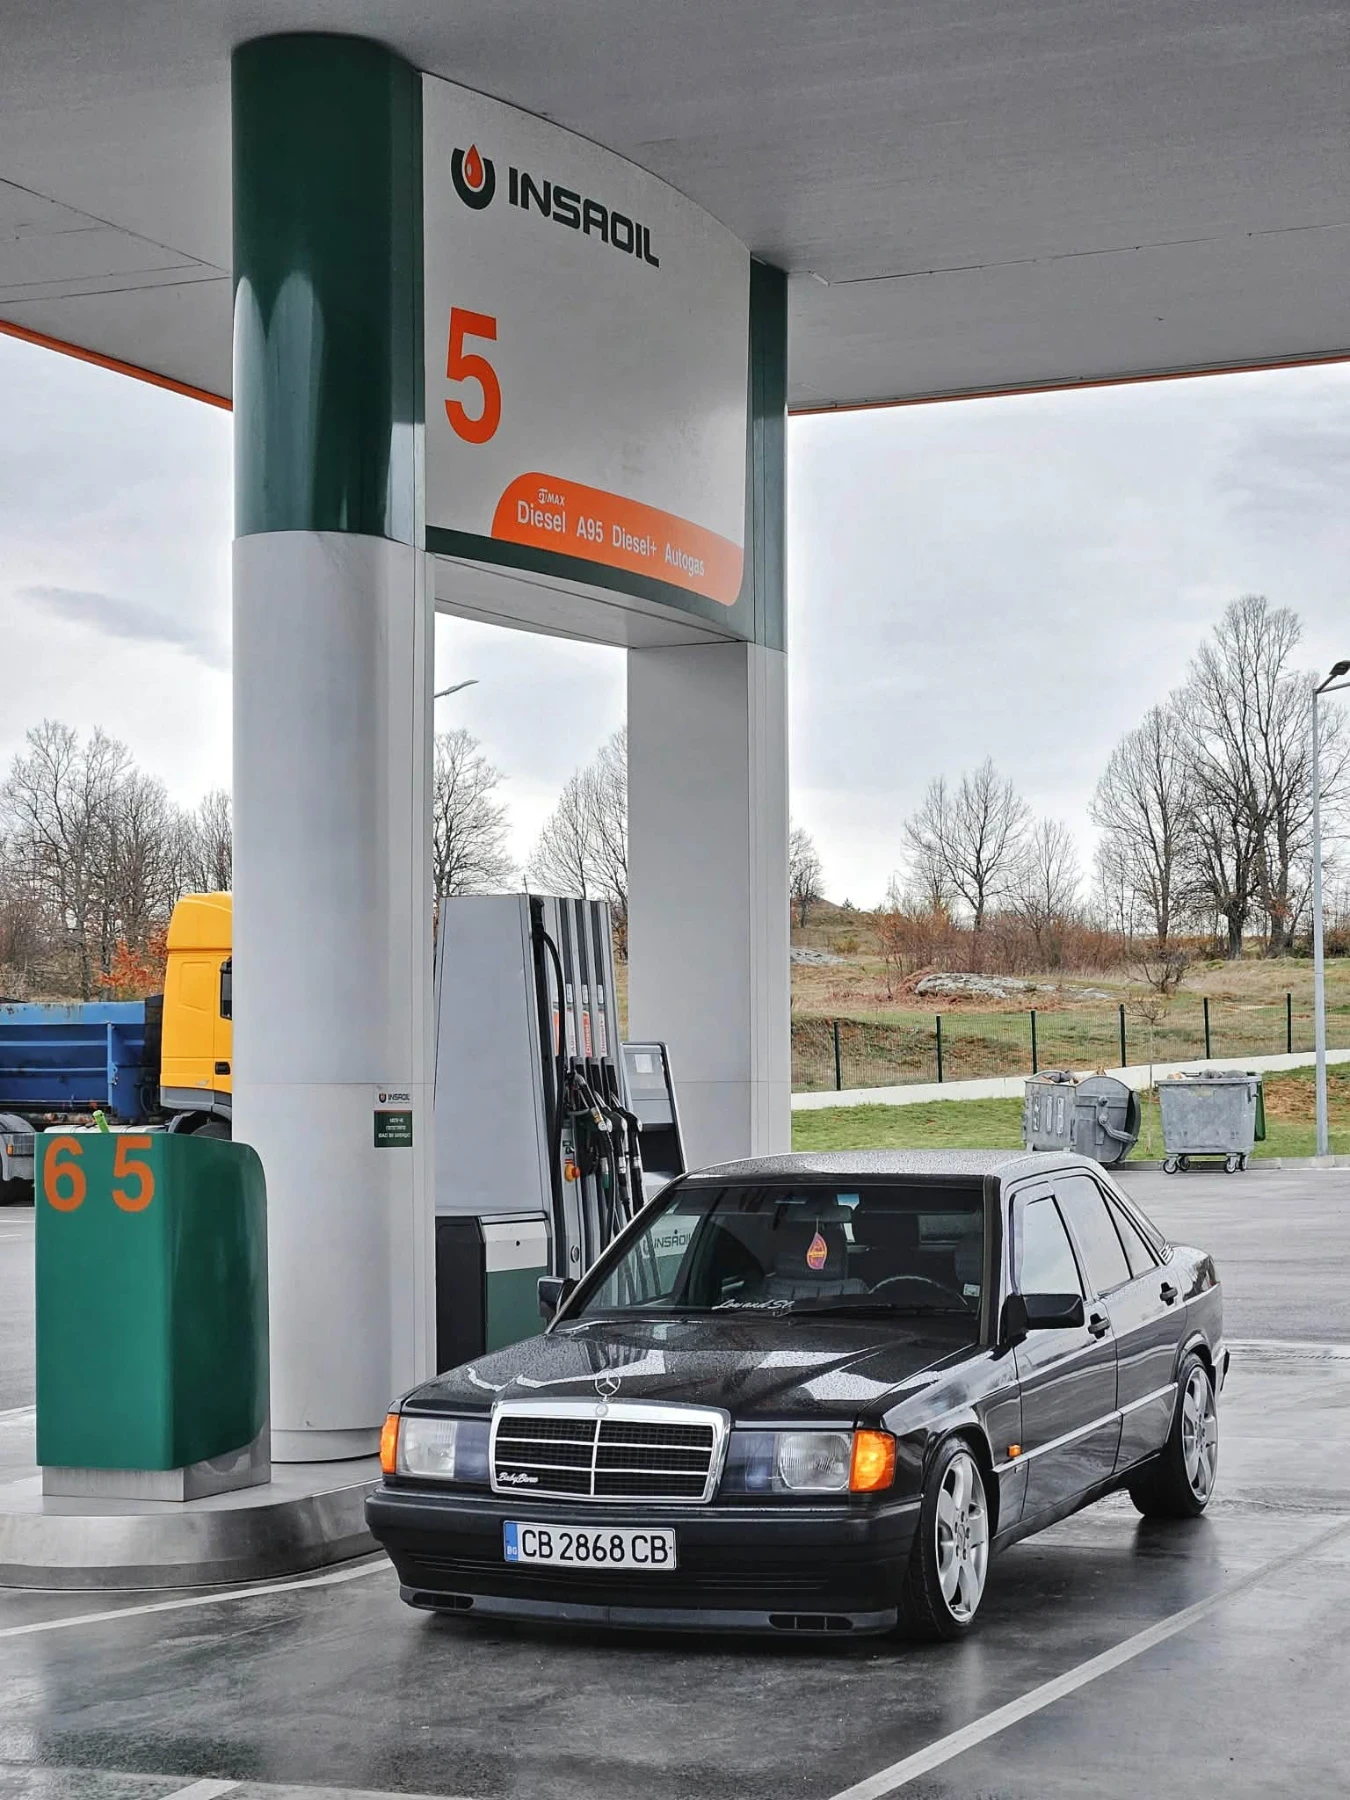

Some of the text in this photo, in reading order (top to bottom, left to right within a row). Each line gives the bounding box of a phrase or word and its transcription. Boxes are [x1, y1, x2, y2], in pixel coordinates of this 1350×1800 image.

[508, 166, 660, 269] INSAOIL
[444, 307, 502, 445] 5
[517, 500, 705, 577] Diesel A95 Diesel+ Autogas
[43, 1135, 154, 1212] 6 5
[521, 1529, 668, 1564] CB 2868 CB
